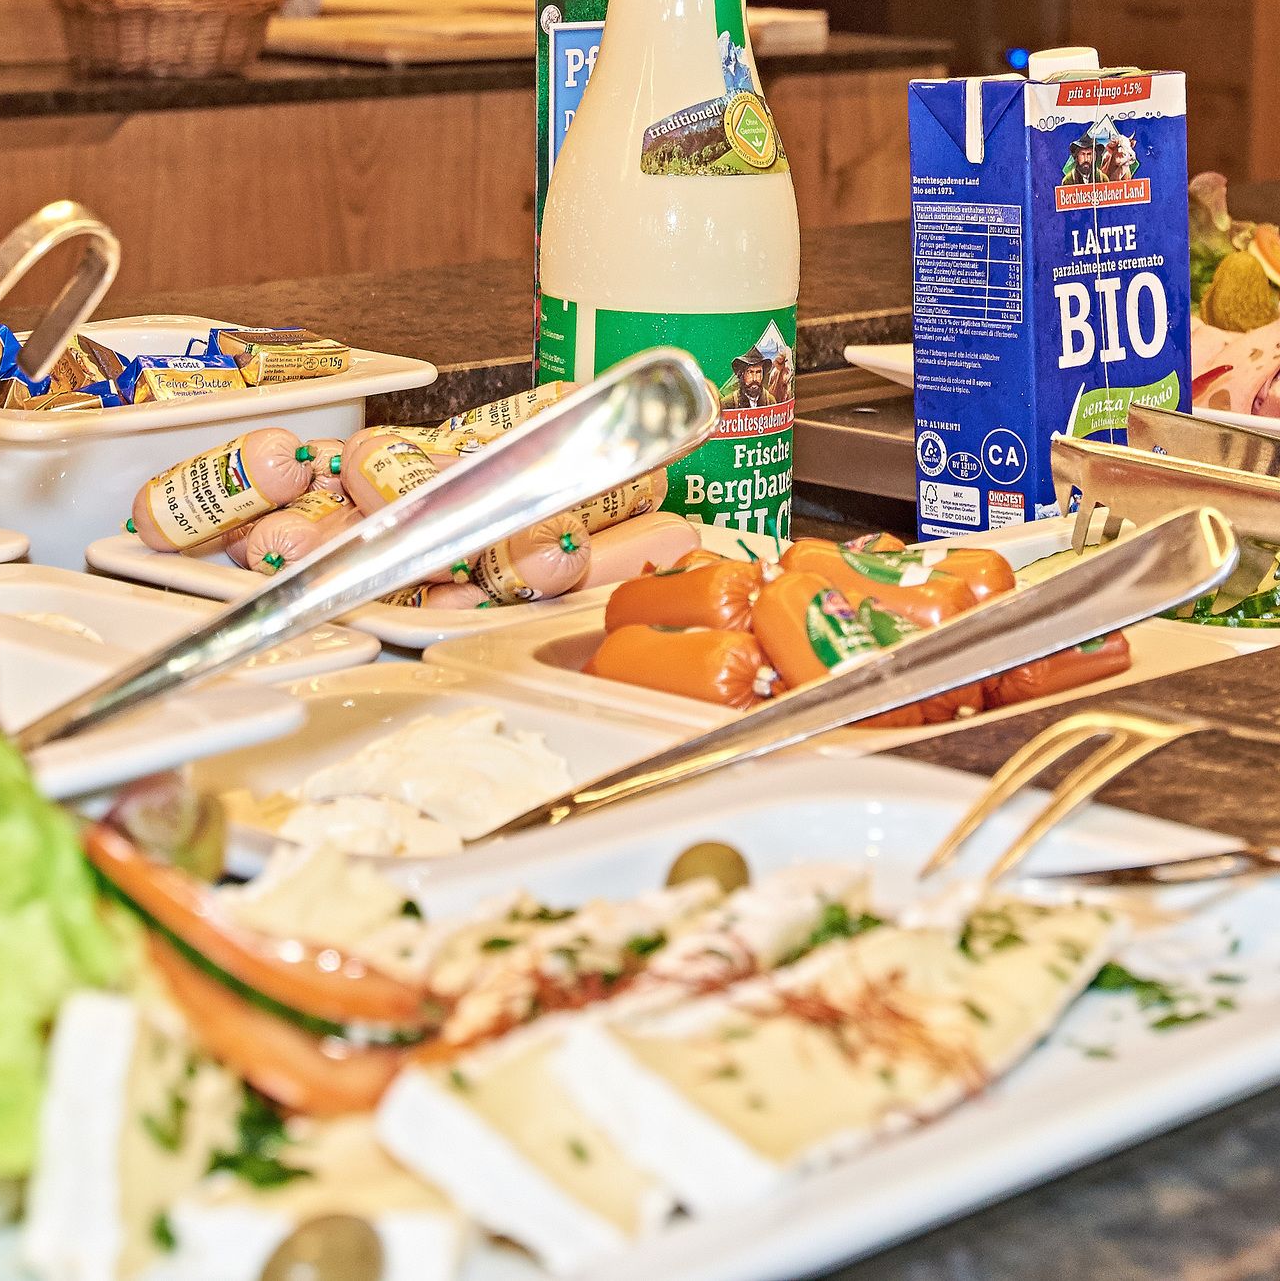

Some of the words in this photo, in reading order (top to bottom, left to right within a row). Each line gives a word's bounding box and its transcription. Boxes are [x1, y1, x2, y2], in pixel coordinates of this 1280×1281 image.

[1067, 87, 1083, 102] più
[1085, 88, 1091, 98] a
[649, 102, 722, 139] traditionell
[965, 177, 980, 186] Land
[913, 187, 924, 195] Bio
[924, 187, 937, 195] seit
[937, 187, 955, 196] 1973.
[1124, 181, 1145, 199] Land
[1072, 224, 1137, 256] LATTE
[1053, 259, 1117, 281] parzialmente
[1118, 253, 1164, 271] scremato
[1053, 271, 1168, 369] BIO
[172, 361, 201, 369] MEGGLE
[154, 373, 189, 389] Feine
[190, 373, 233, 389] Butter
[1083, 398, 1123, 419] senza
[917, 418, 928, 428] PER
[929, 420, 961, 432] ALIMENTI
[733, 437, 790, 469] Frische
[960, 454, 969, 462] DE
[952, 460, 960, 469] BY
[164, 479, 199, 536] 16.08.2017
[925, 504, 939, 513] FSC
